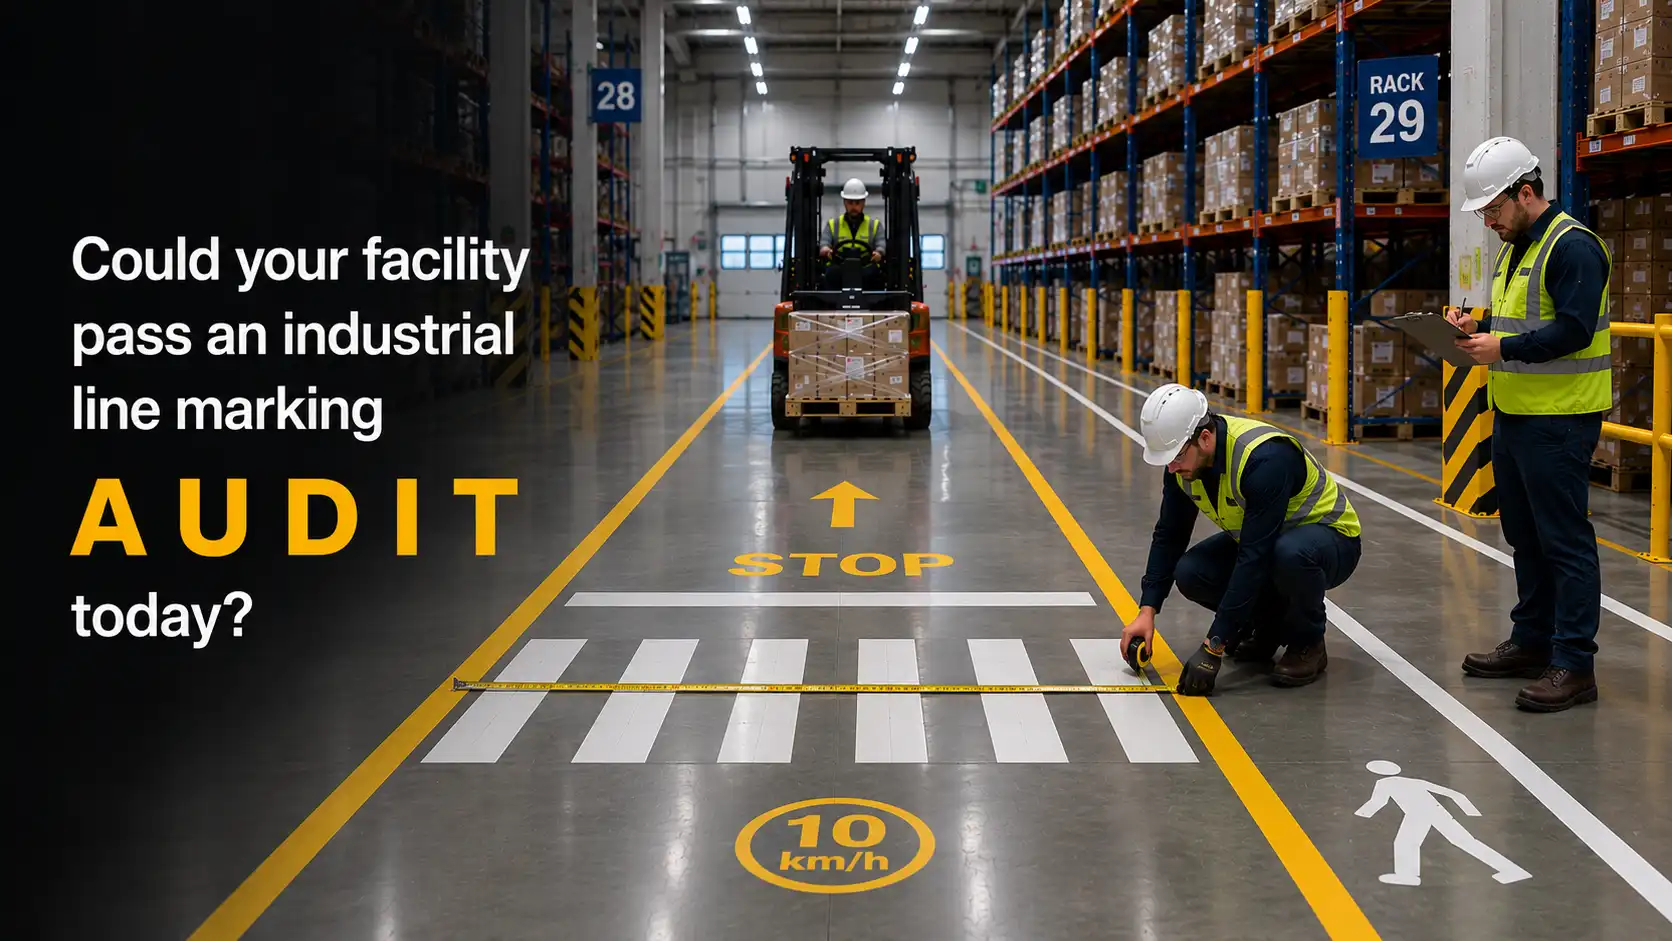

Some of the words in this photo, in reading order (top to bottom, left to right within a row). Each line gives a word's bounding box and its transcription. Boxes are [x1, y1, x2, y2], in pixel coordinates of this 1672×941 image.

[597, 81, 636, 110] 28
[1370, 72, 1425, 95] RACK
[1369, 99, 1425, 144] 29
[728, 552, 955, 577] STOP
[787, 815, 886, 848] 10
[779, 852, 889, 873] km/h
